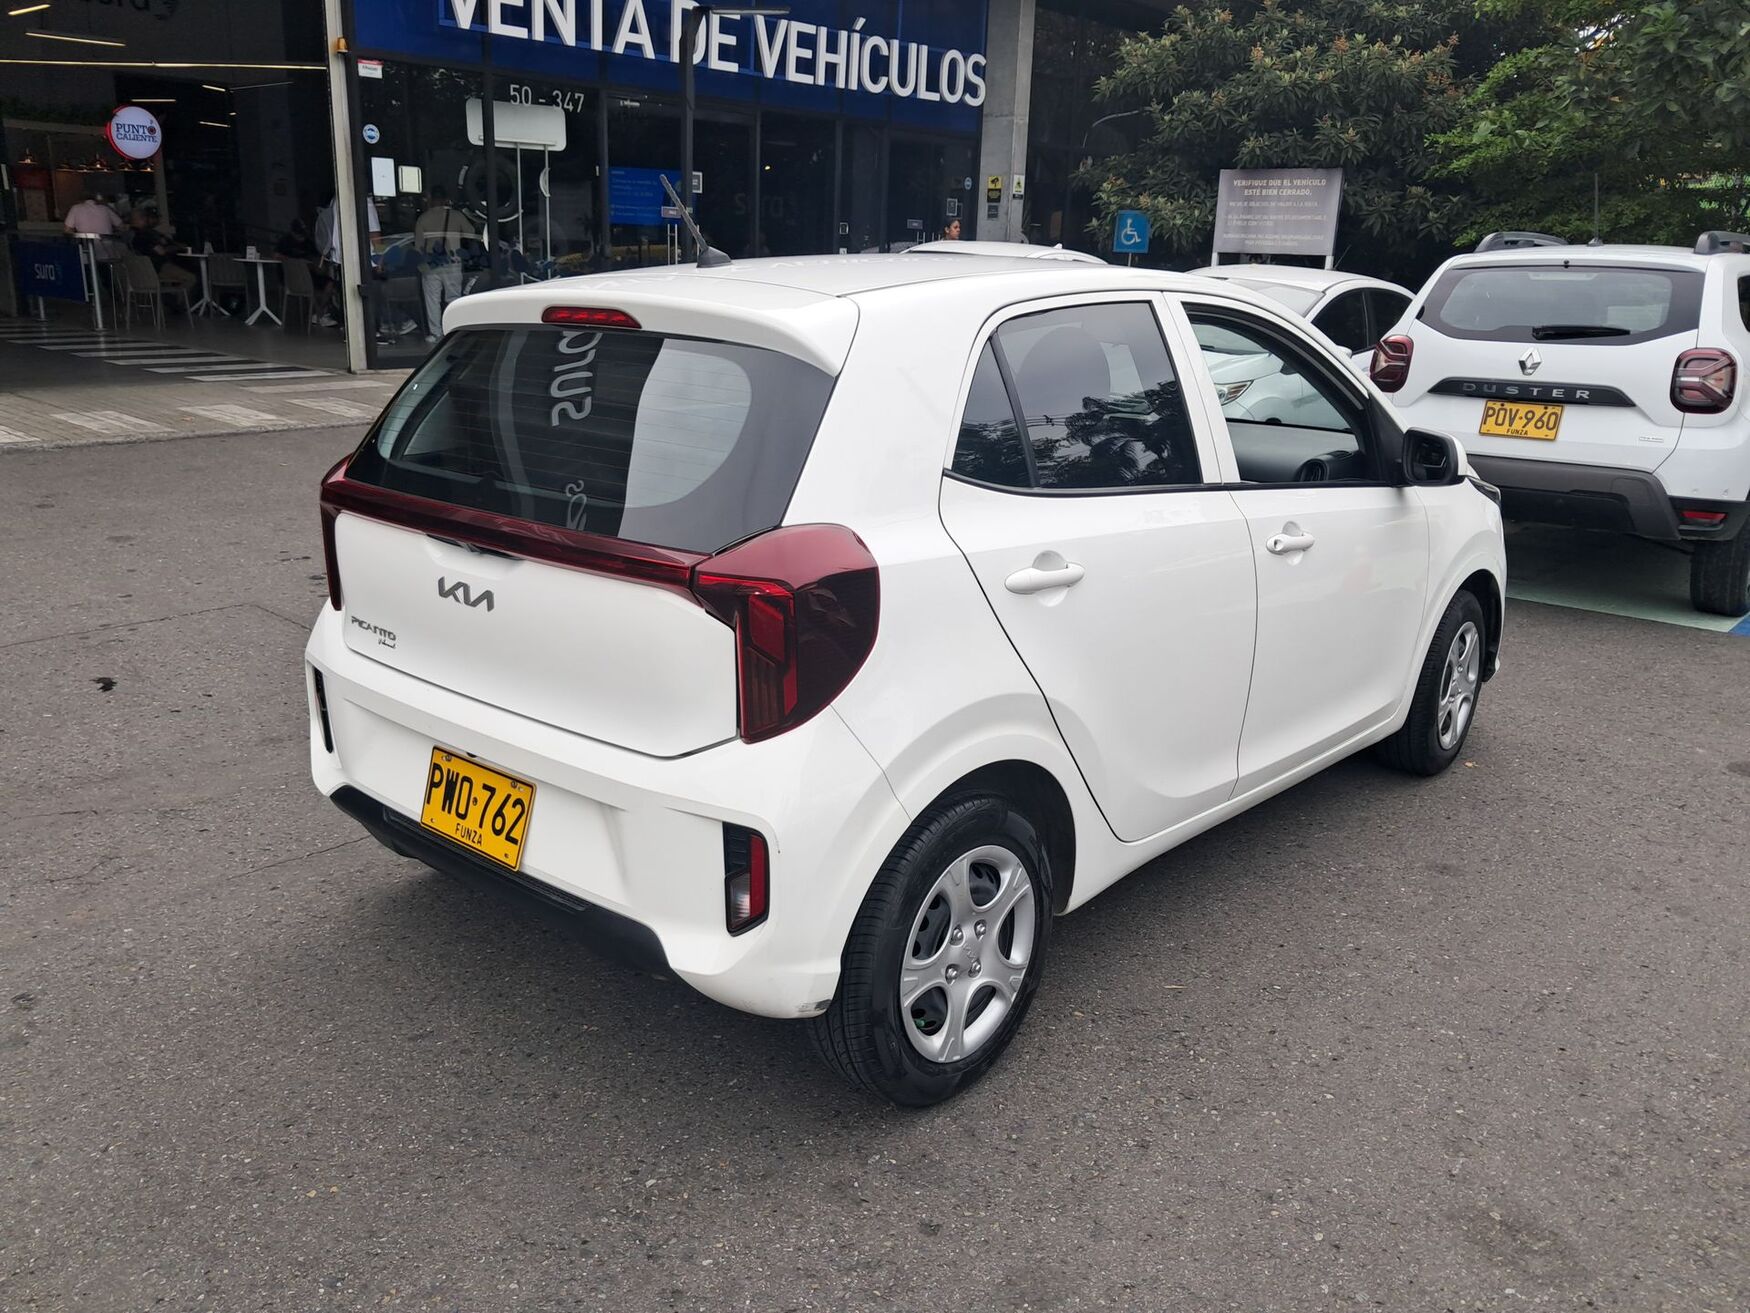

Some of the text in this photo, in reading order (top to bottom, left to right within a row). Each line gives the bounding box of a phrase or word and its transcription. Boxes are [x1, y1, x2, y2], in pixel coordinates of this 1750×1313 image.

[670, 0, 741, 73] DE
[754, 14, 987, 107] VEHÍCULOS
[509, 84, 532, 106] 50
[552, 90, 585, 113] 347
[115, 122, 157, 135] PUNTO
[116, 132, 158, 143] CALIENTE
[1268, 179, 1282, 187] QUE
[1293, 176, 1327, 186] VEHÍCULO
[1261, 188, 1278, 196] BIEN
[1462, 383, 1591, 399] DUSTER
[1506, 428, 1529, 436] FUNZA
[437, 576, 495, 612] KIA
[351, 615, 396, 642] PICANTO
[455, 822, 483, 848] FUNZA
